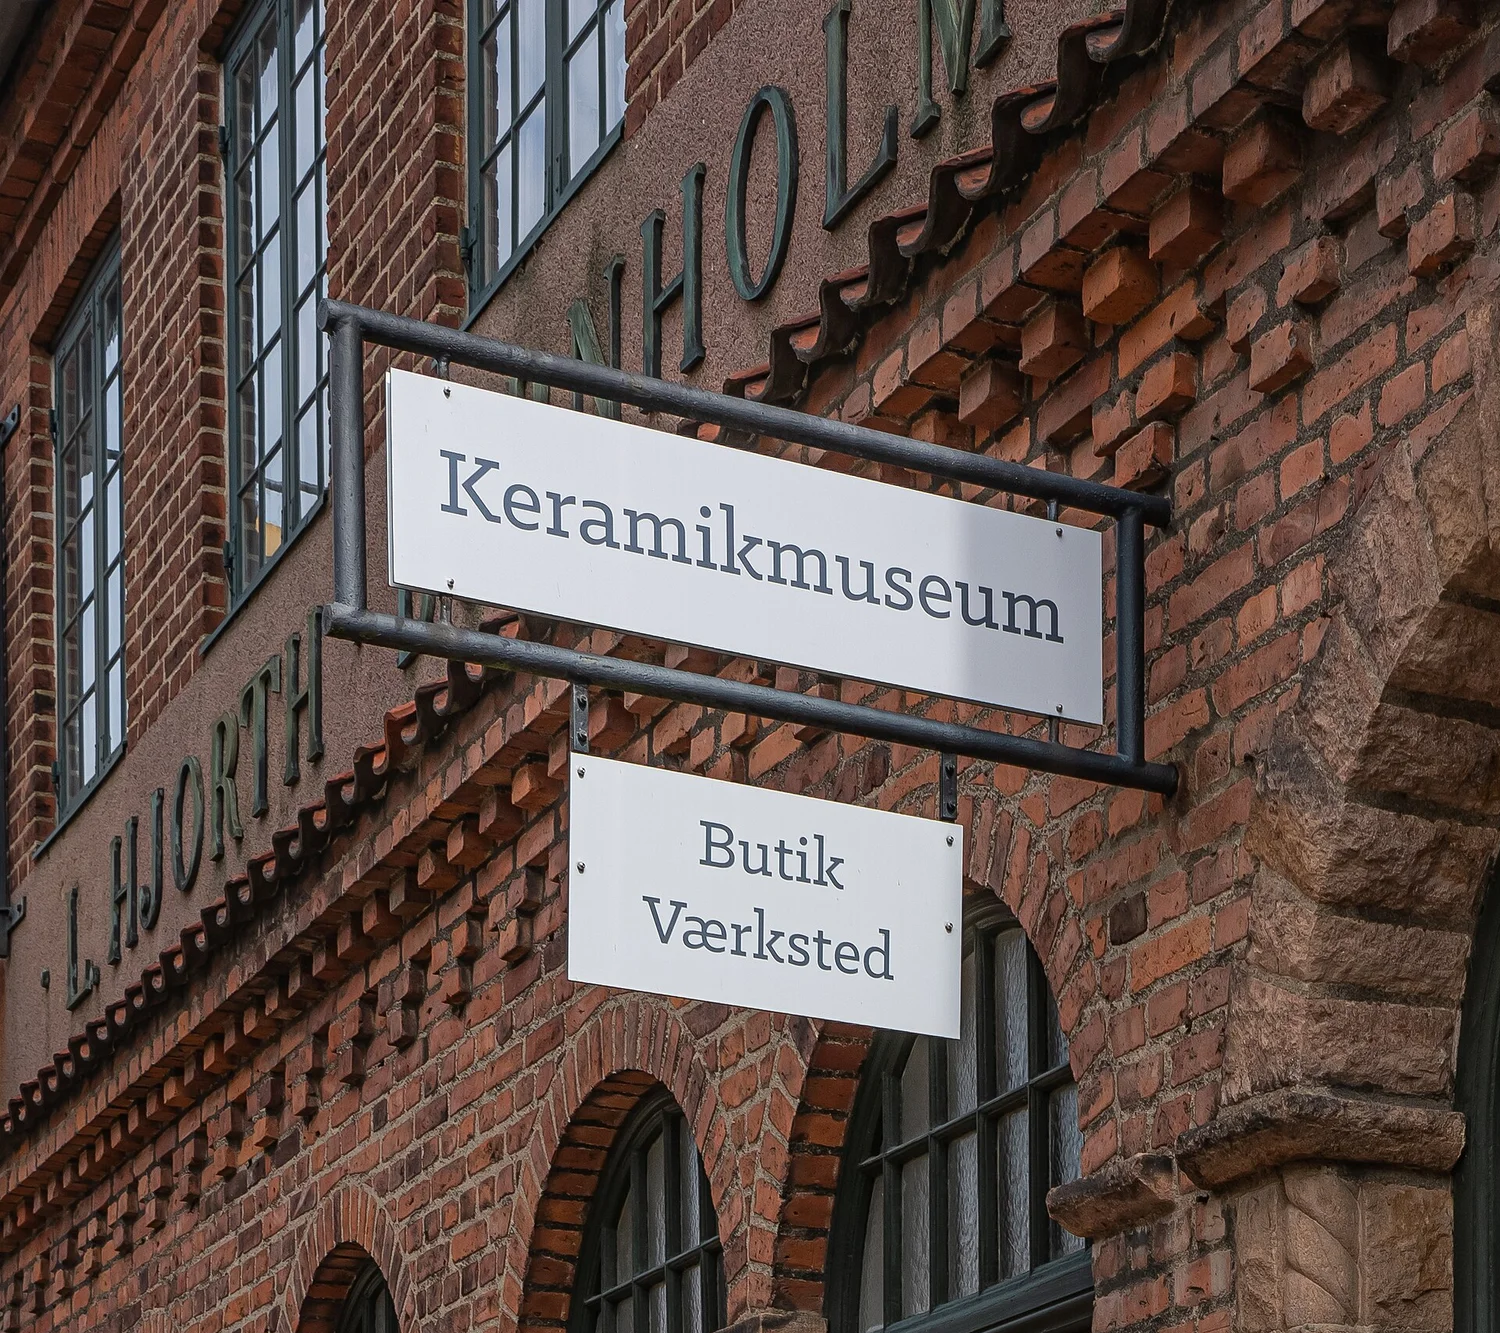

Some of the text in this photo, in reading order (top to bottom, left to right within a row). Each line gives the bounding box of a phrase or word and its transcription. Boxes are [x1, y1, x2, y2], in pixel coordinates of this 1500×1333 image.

[440, 450, 1064, 645] Keramikmuseum
[107, 605, 324, 966] HJORTH
[700, 820, 844, 890] Butik
[643, 896, 894, 981] Værksted
